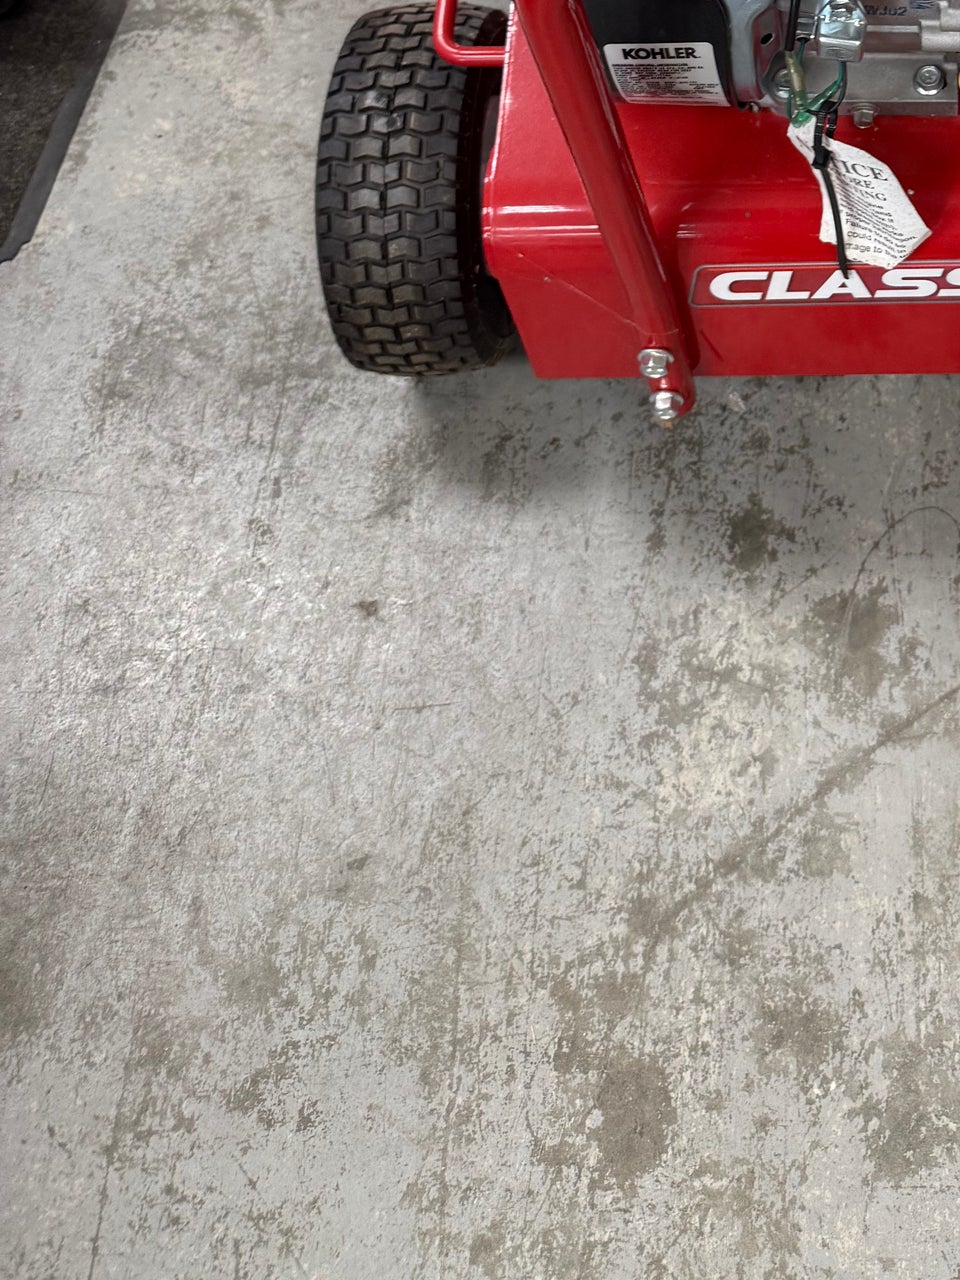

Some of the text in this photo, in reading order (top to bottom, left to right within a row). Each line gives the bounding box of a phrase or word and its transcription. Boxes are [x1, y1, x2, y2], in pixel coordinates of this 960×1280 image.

[622, 46, 698, 60] KOHLER
[847, 230, 872, 242] could
[873, 246, 883, 254] to
